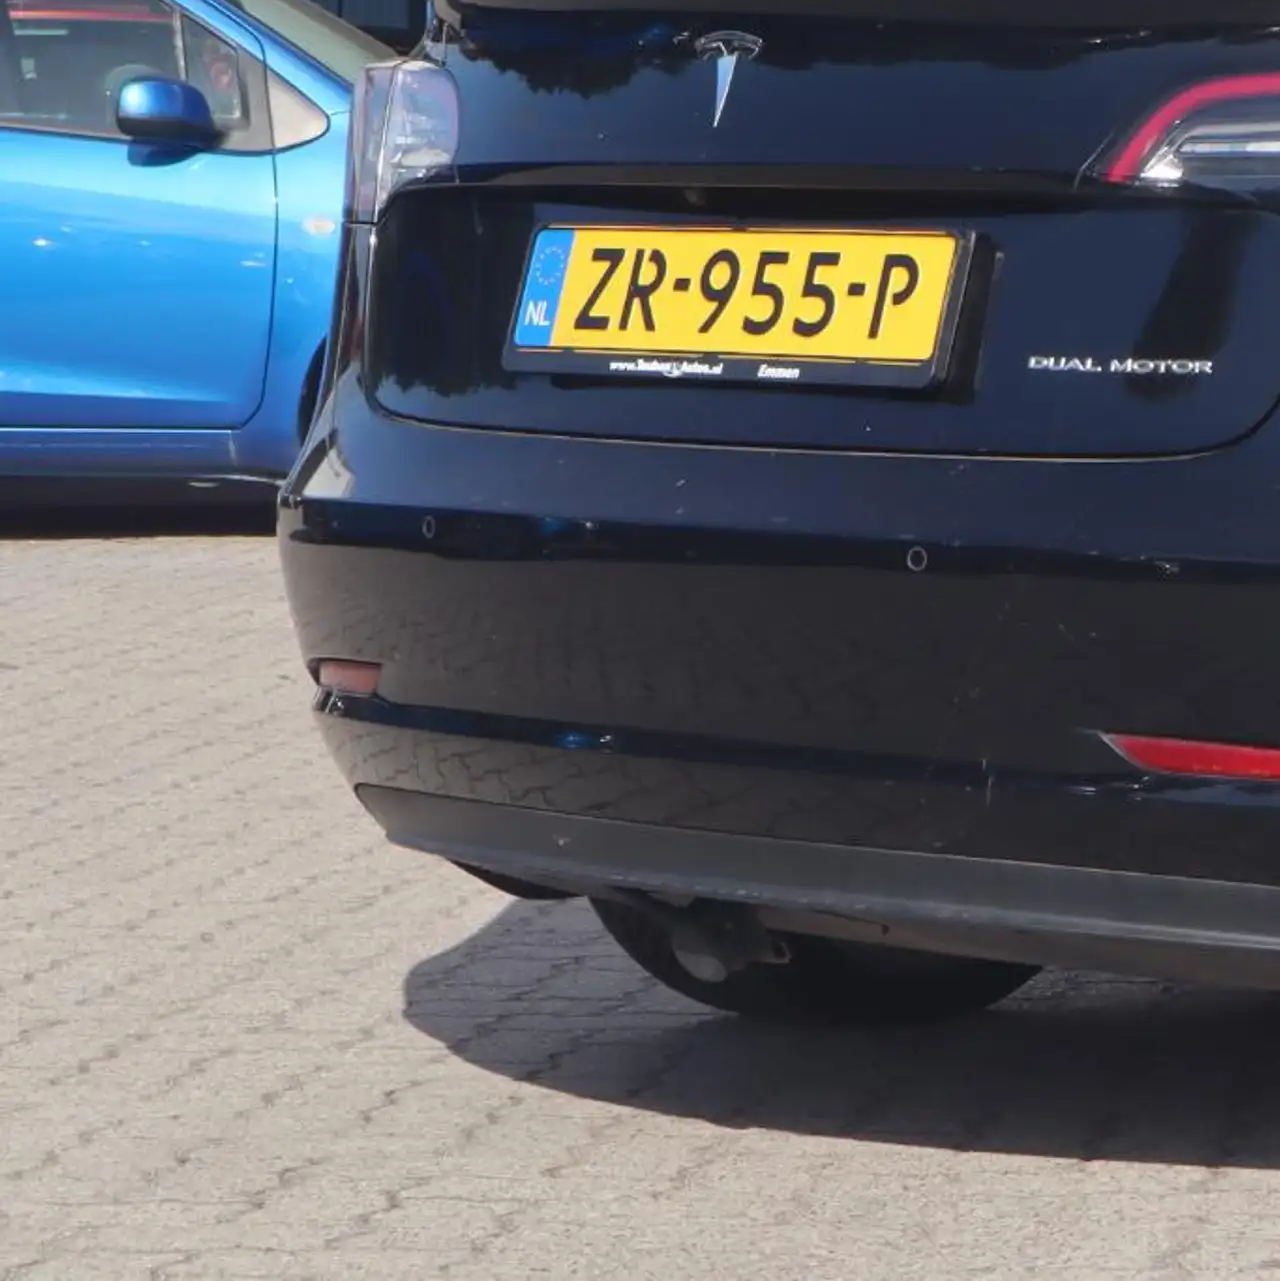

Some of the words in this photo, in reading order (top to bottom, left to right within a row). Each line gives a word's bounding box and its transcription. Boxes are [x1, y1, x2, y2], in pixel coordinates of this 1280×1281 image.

[573, 247, 919, 339] ZR-955-P
[524, 300, 550, 326] NL
[1028, 356, 1097, 372] DUAL
[1110, 358, 1213, 374] MOTOR
